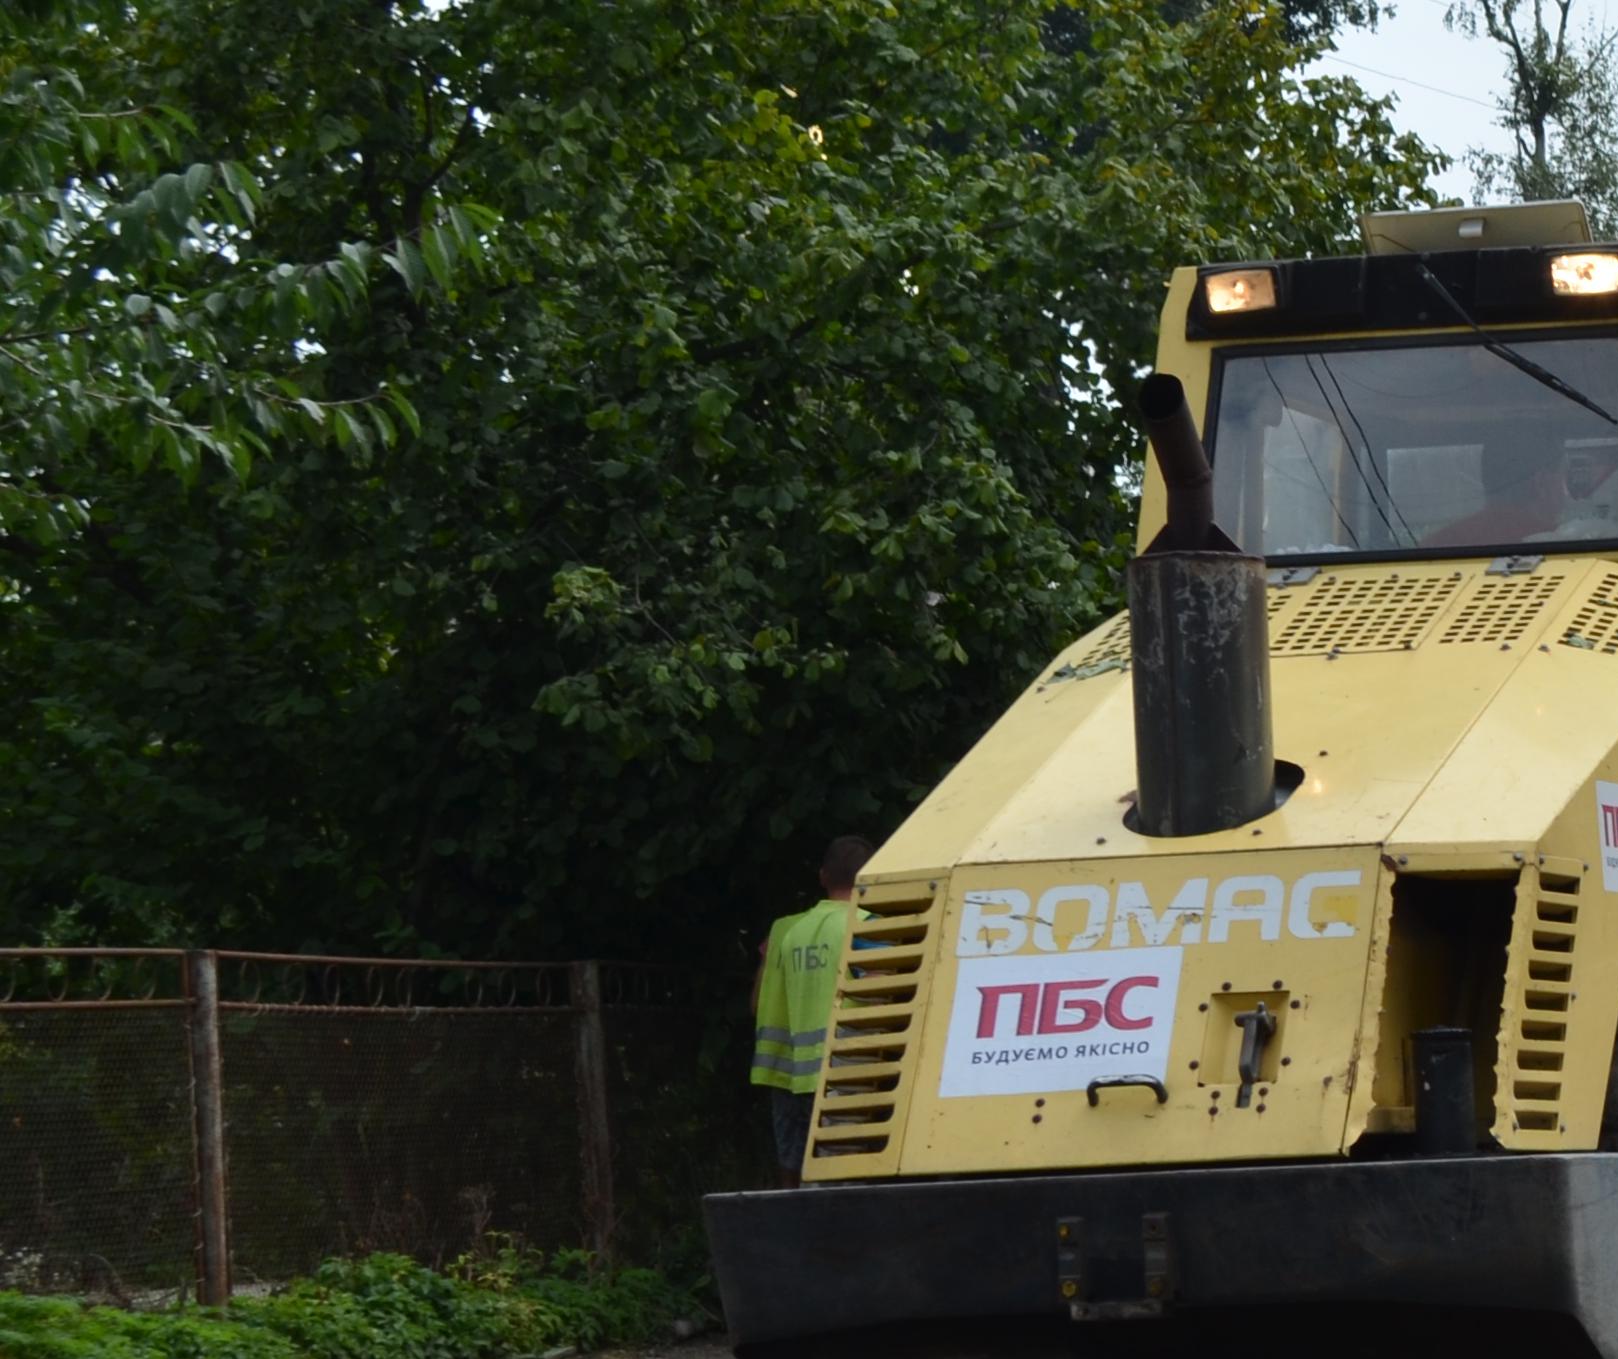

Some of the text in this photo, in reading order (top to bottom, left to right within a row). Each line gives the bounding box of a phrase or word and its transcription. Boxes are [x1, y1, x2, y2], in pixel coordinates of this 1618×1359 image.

[792, 943, 829, 972] ПБС
[977, 976, 1159, 1039] ПБС
[971, 1041, 1150, 1065] БУДУЄМО ЯКІСНО
